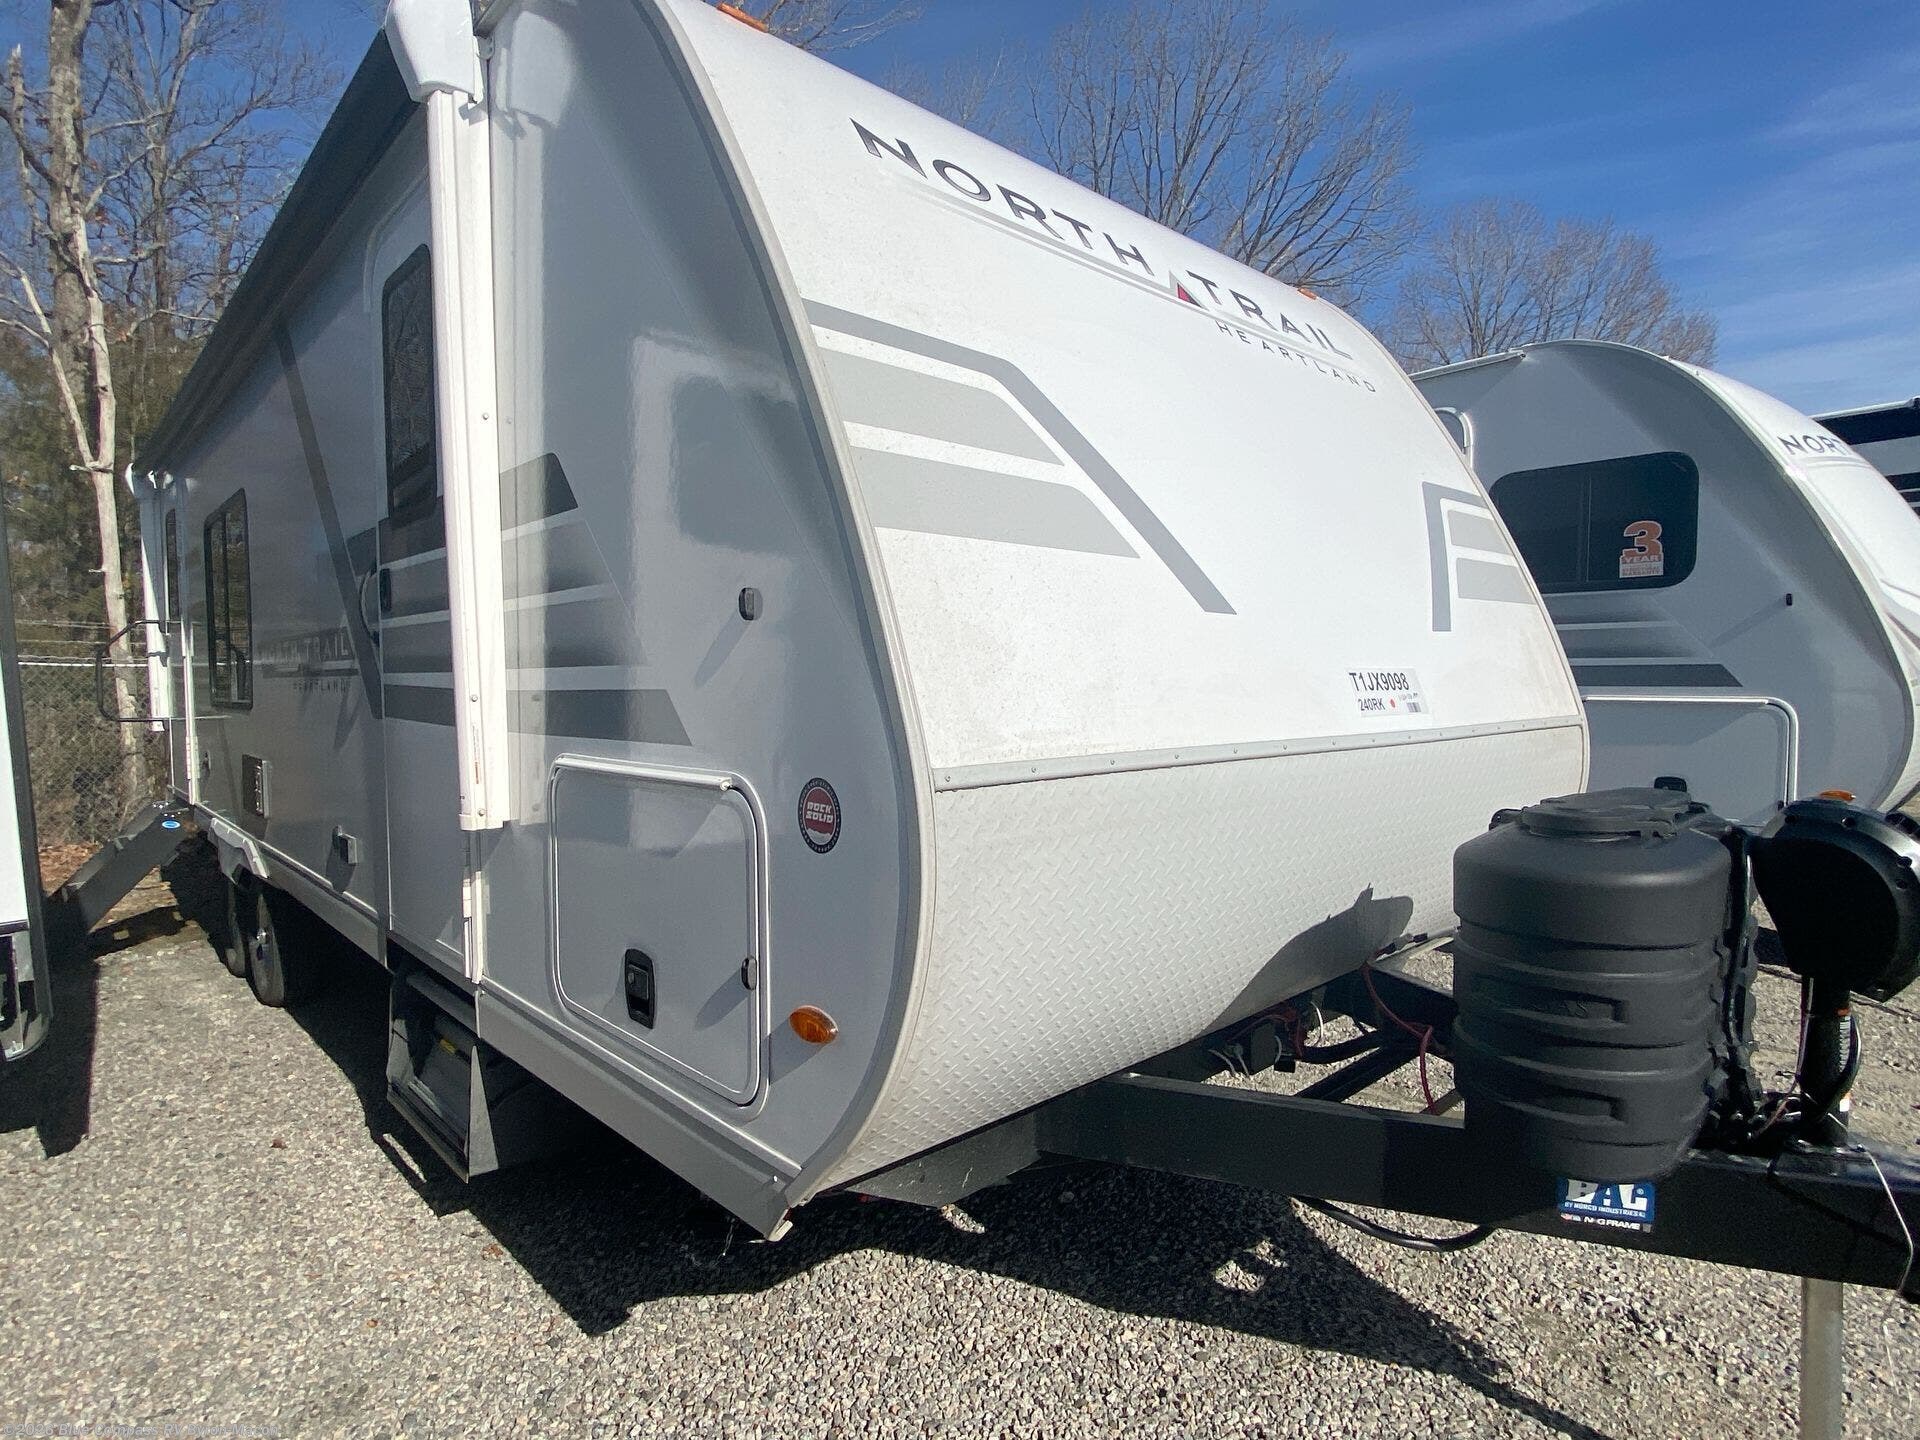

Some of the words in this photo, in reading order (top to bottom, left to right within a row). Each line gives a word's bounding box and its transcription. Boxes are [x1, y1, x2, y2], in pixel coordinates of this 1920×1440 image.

[849, 117, 1155, 276] NORTH
[1187, 270, 1353, 361] TRAIL
[1215, 320, 1376, 393] HEARTLAND
[1622, 520, 1663, 557] 3
[1624, 554, 1661, 564] YEAR
[1348, 672, 1410, 691] T1JX9098
[1358, 698, 1386, 712] 240RK
[807, 801, 832, 814] ROCK
[805, 810, 834, 824] SOLID
[1598, 1206, 1638, 1216] INDUSTRIES
[1606, 1219, 1640, 1230] FRAME
